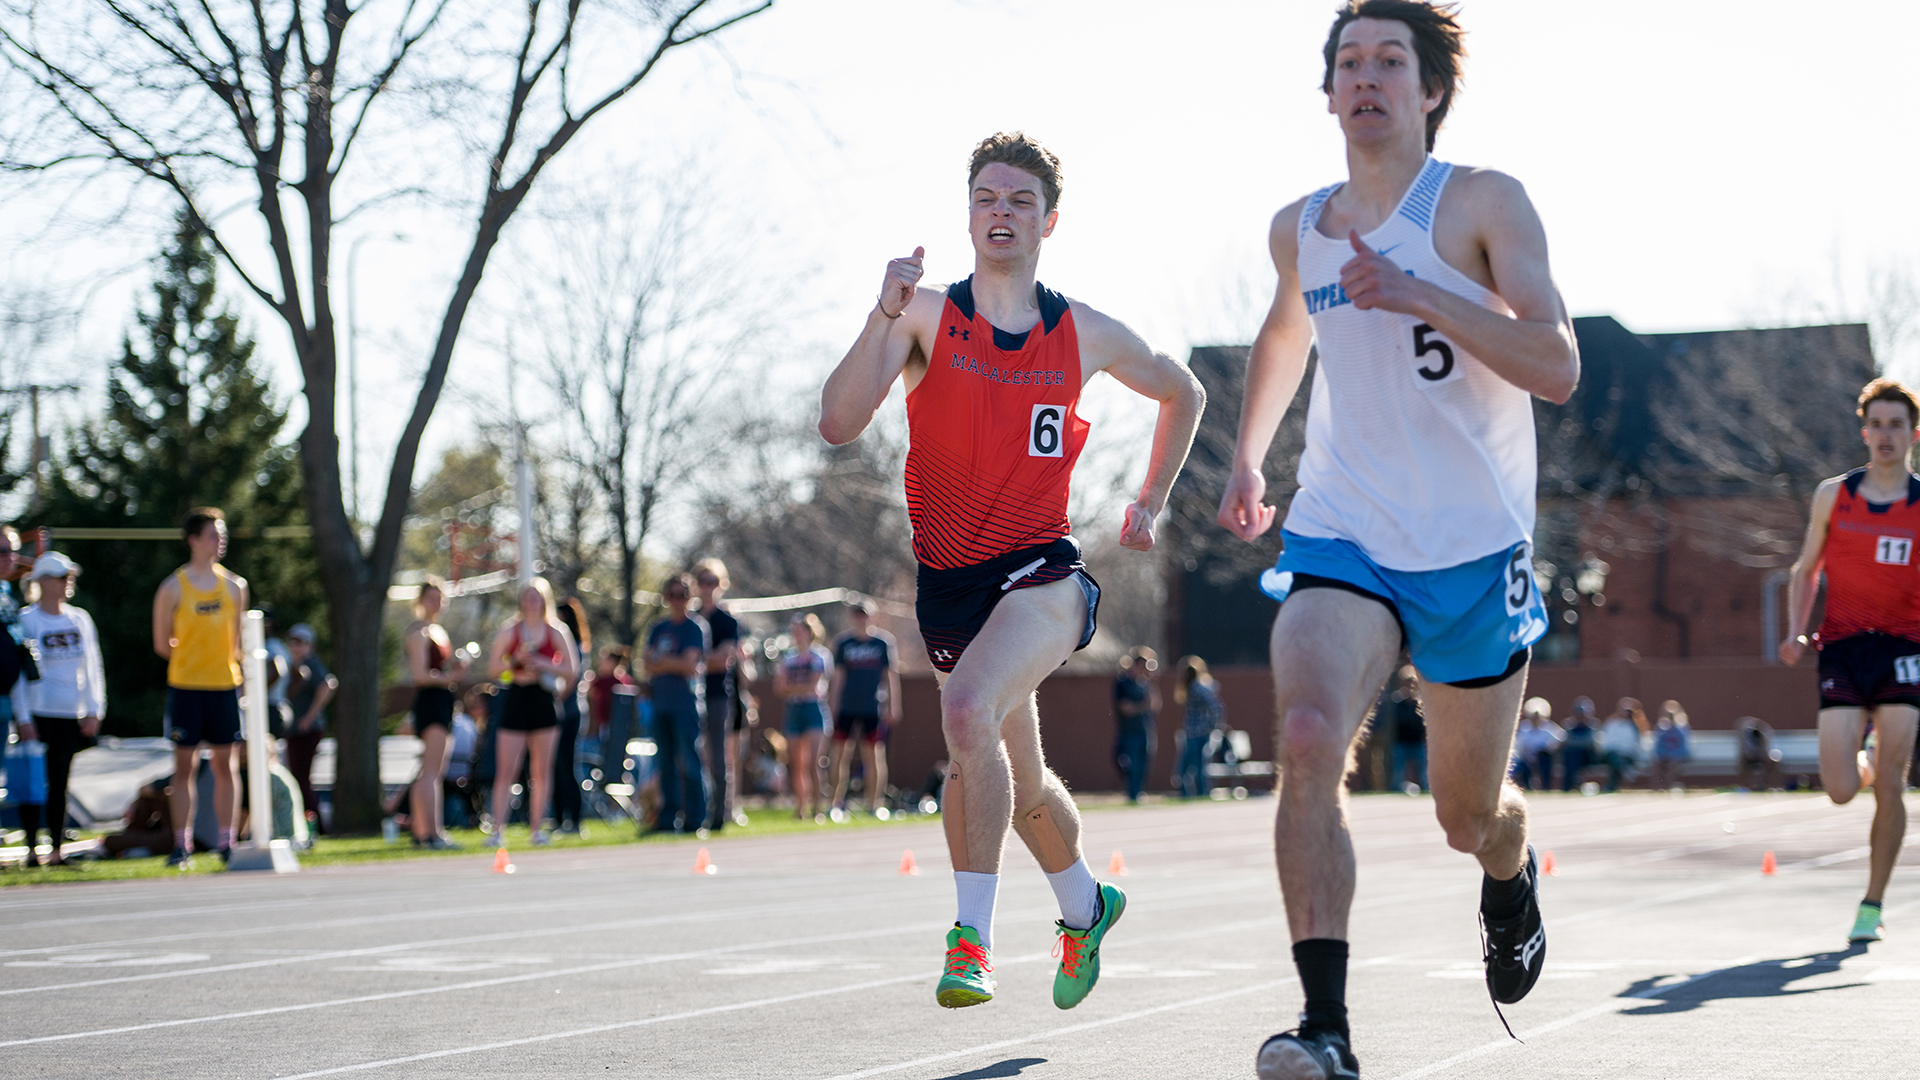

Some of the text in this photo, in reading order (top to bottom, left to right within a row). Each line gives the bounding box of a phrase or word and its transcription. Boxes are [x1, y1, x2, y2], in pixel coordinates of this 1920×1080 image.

[950, 353, 1065, 386] MACALESTER
[1413, 323, 1454, 381] 5
[1033, 408, 1060, 454] 6
[1881, 541, 1907, 561] 11
[1509, 548, 1529, 608] 5
